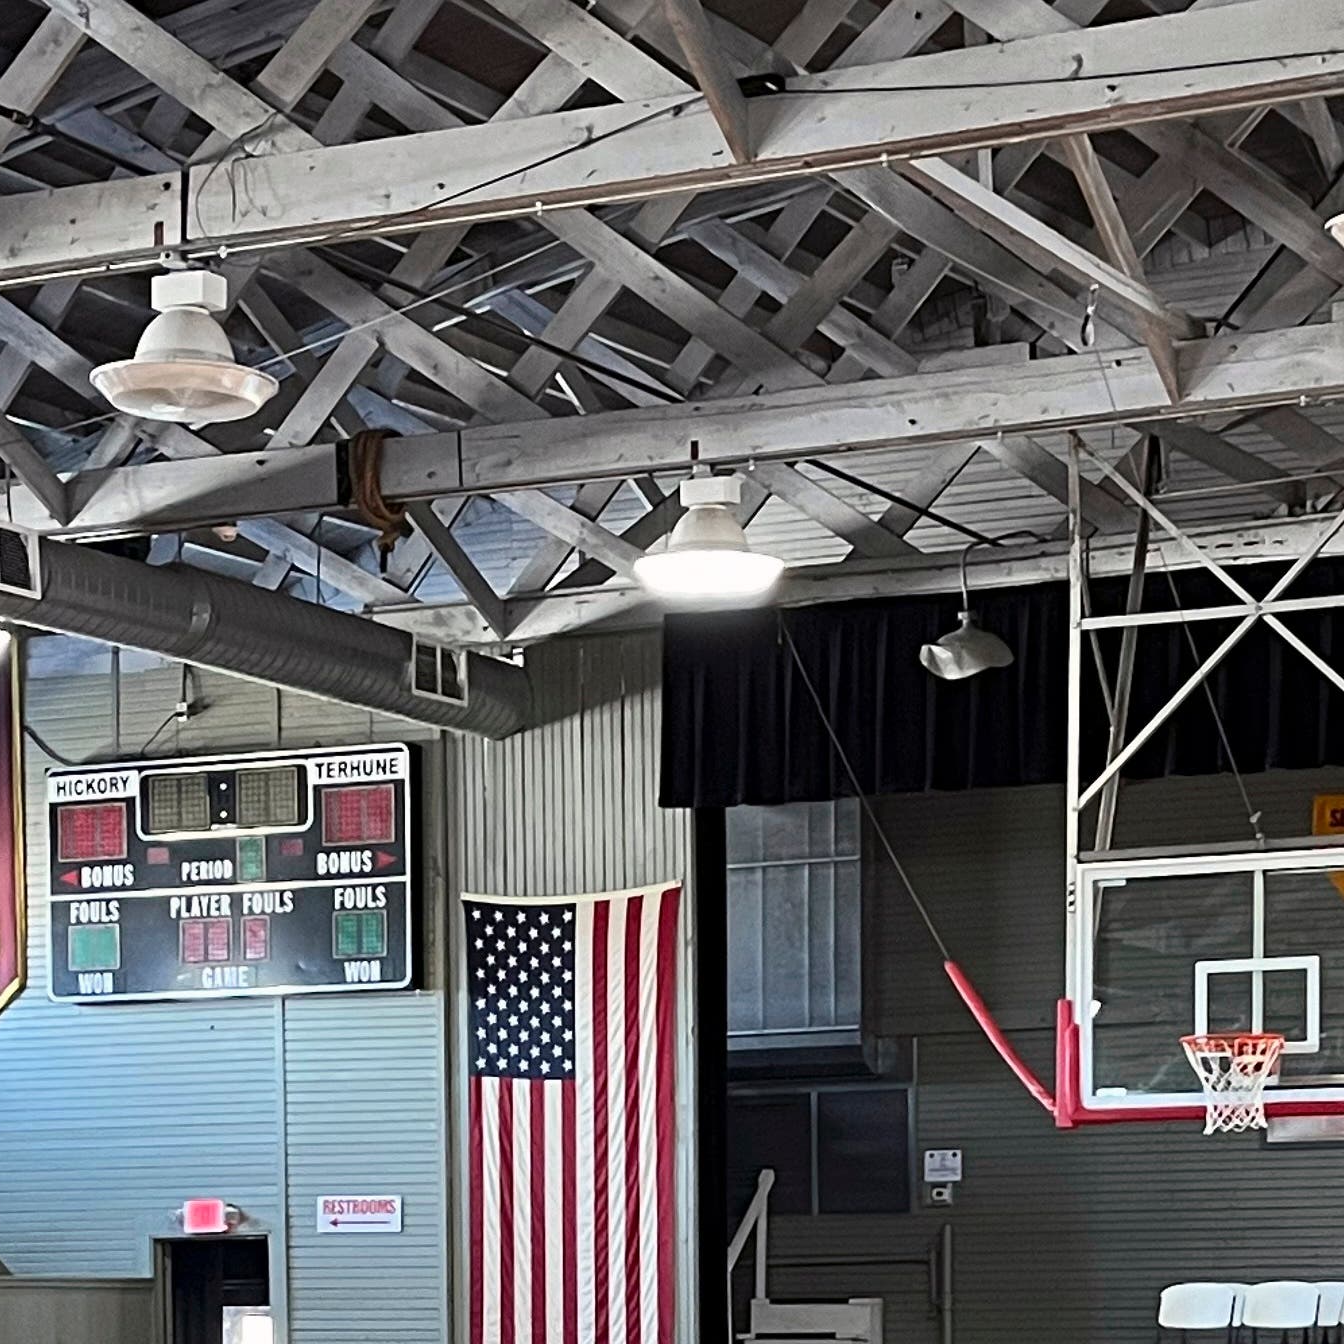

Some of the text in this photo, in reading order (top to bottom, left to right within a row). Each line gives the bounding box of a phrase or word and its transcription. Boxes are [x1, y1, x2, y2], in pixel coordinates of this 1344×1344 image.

[315, 758, 399, 779] TERHUNE
[56, 775, 130, 797] HICKORY
[181, 858, 233, 881] PERIOD
[316, 851, 373, 875] BONUS
[80, 864, 135, 888] BONUS
[169, 890, 294, 919] PLAYER FOULS
[334, 886, 387, 910] FOULS
[69, 900, 120, 923] FOULS
[78, 972, 114, 994] WON
[344, 960, 382, 983] WON
[322, 1199, 396, 1215] RESTROOMS
